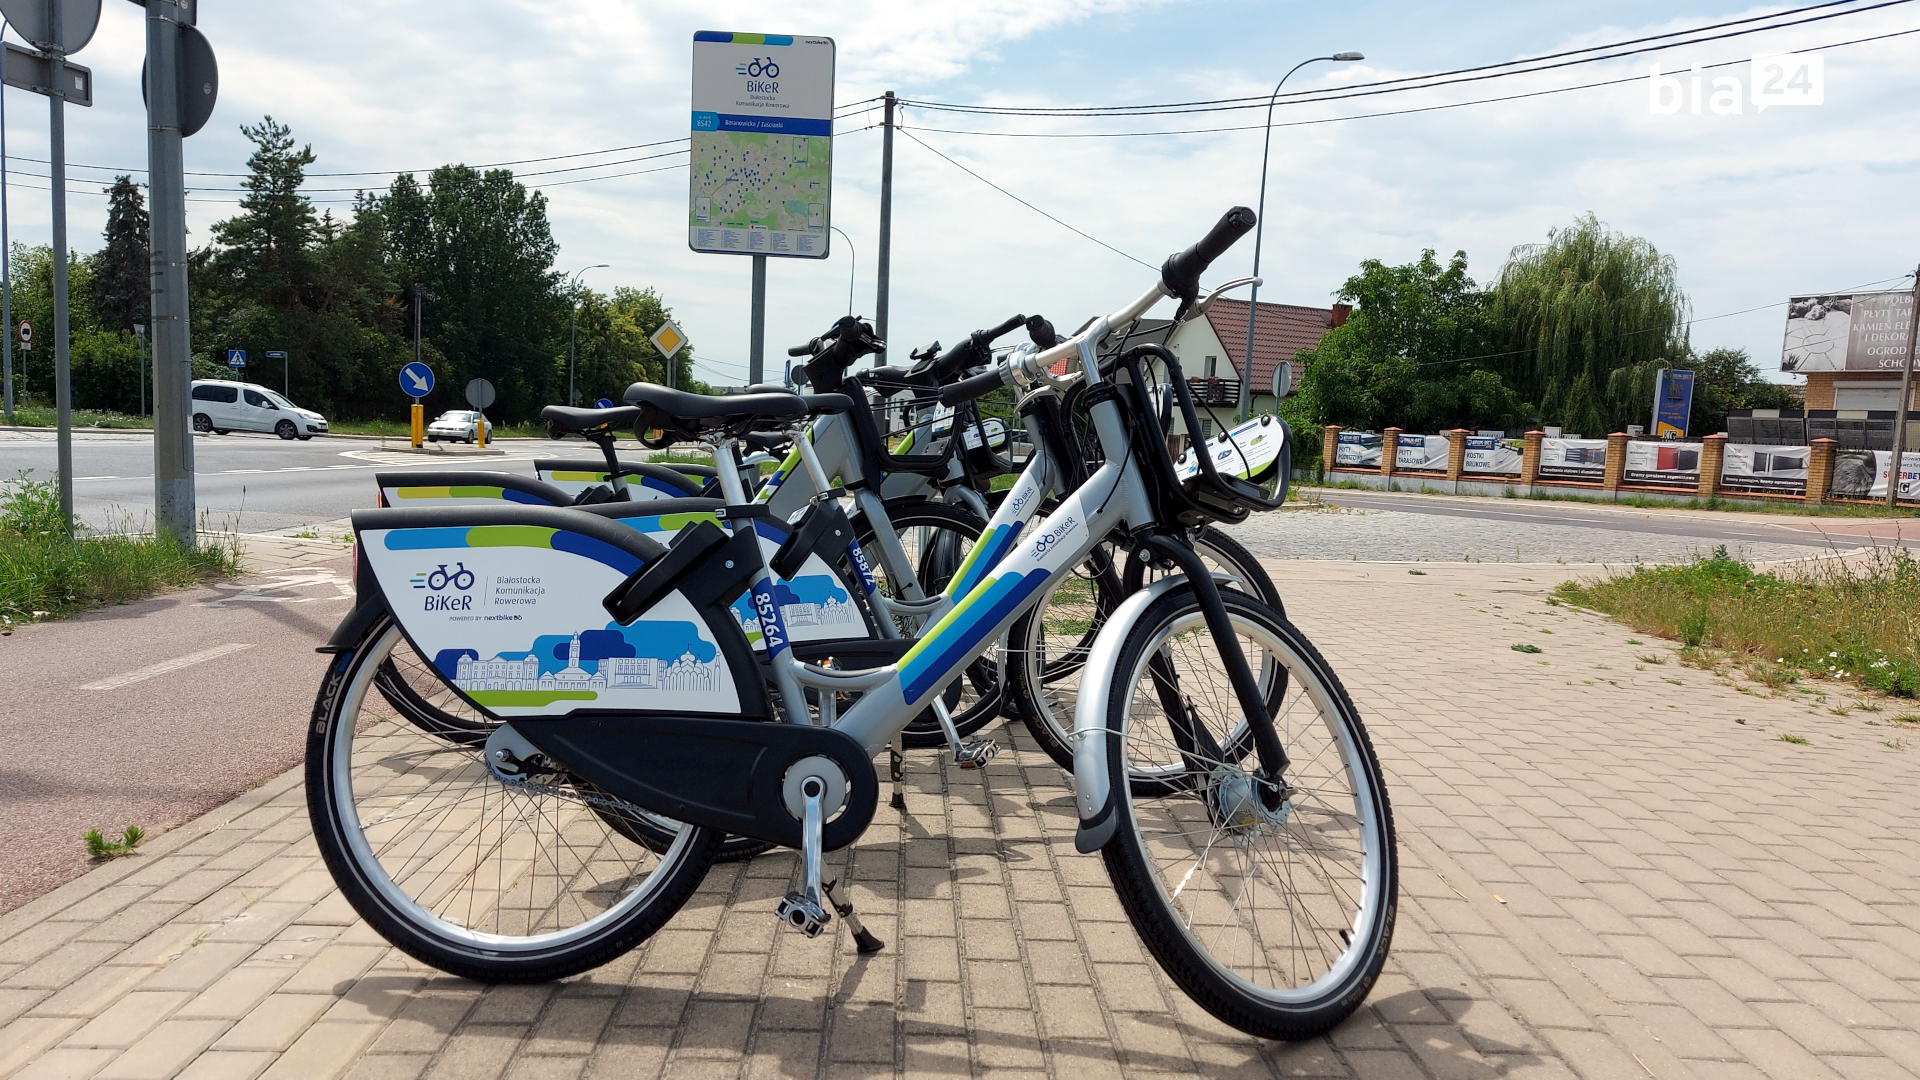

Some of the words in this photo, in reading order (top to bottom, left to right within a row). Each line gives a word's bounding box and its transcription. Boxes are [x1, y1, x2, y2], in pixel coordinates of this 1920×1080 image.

[746, 80, 779, 94] BiKeR
[1884, 295, 1914, 305] POLB
[1895, 321, 1910, 330] ELE
[1871, 332, 1909, 341] DEKOR
[1867, 345, 1920, 356] OGRODE
[1878, 358, 1920, 368] SCHOY
[1663, 430, 1678, 440] KG
[1053, 516, 1076, 537] BiKeR
[852, 547, 876, 586] 85872
[496, 576, 541, 584] Białostocka
[495, 586, 546, 596] Komunikacja
[424, 594, 473, 612] BiKeR
[494, 597, 537, 605] Rowerowa
[755, 592, 784, 648] 85264
[315, 672, 342, 735] BLACK
